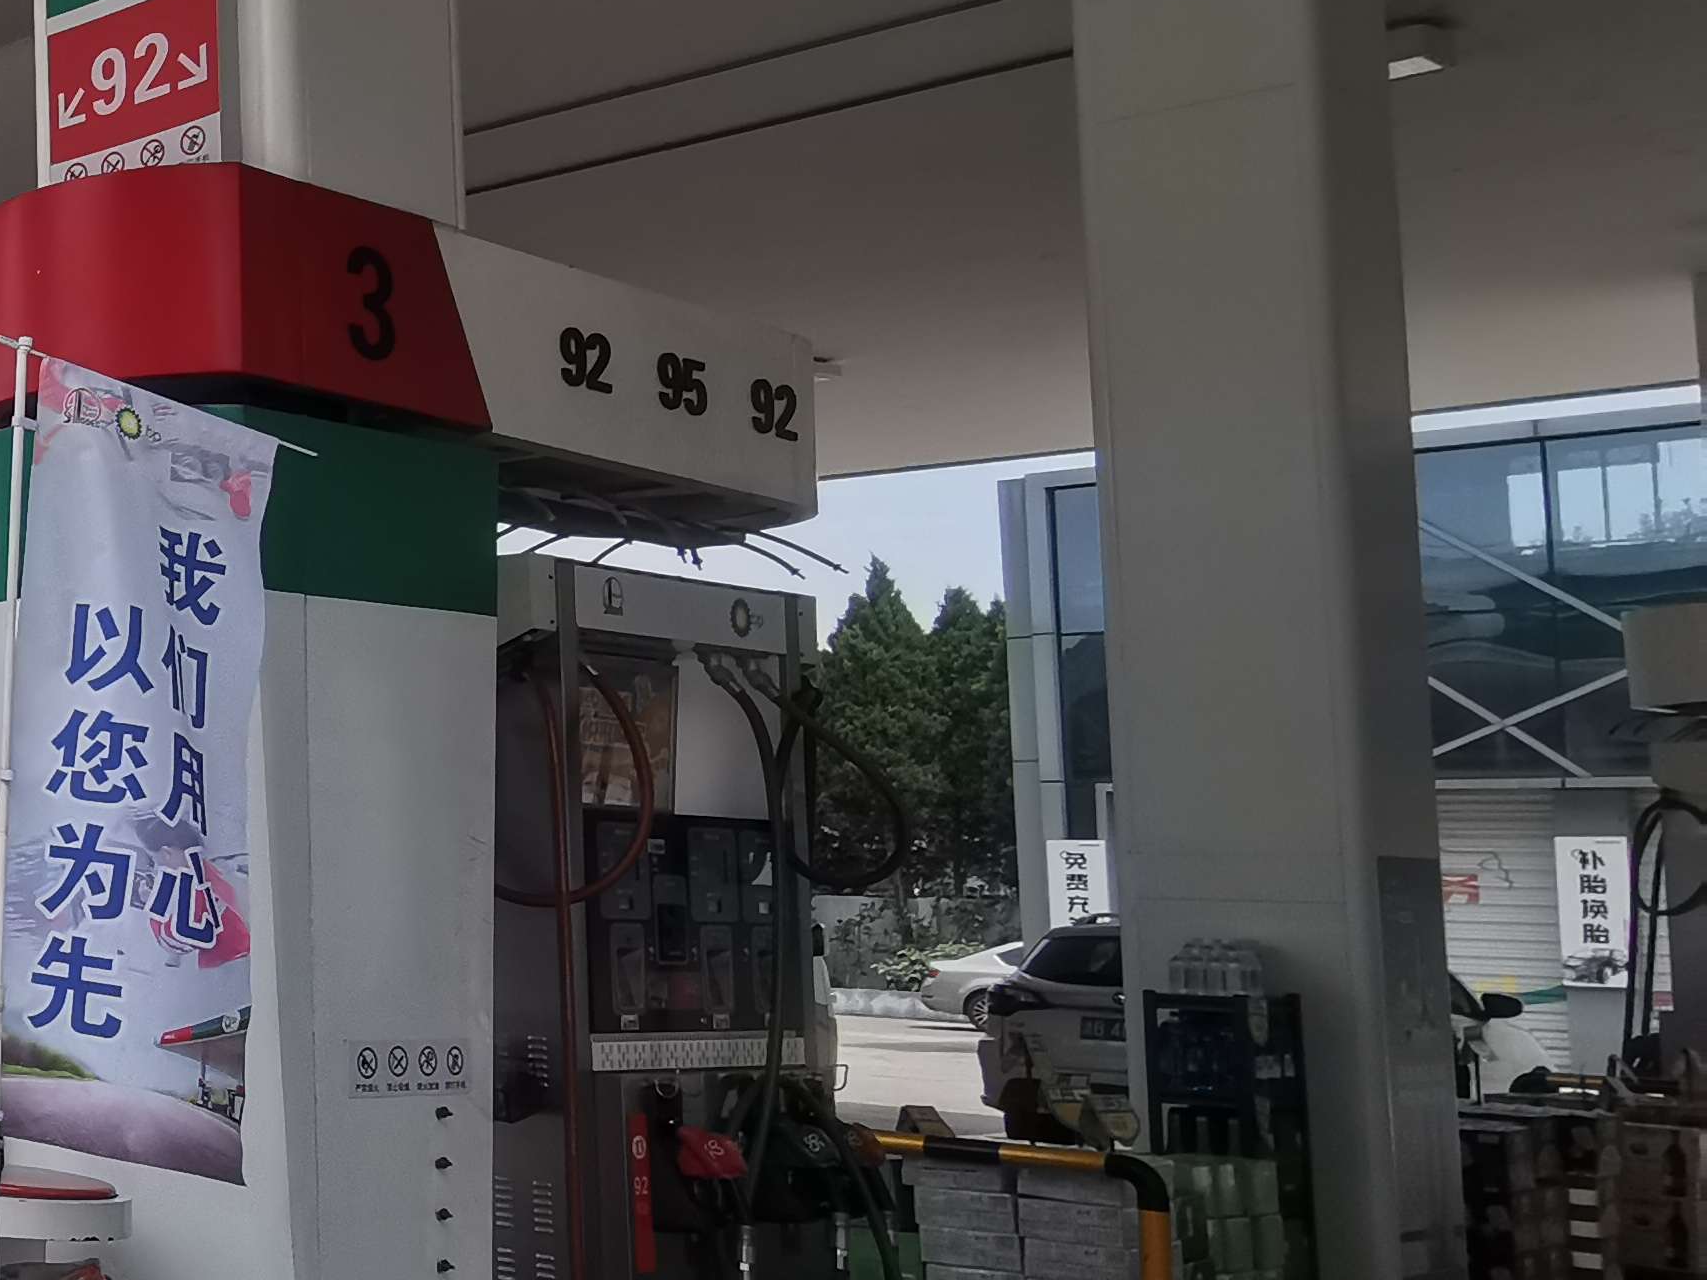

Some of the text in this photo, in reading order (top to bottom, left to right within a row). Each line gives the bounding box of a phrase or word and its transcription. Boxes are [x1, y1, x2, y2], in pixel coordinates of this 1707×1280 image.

[91, 32, 170, 118] 92
[346, 246, 394, 360] 3
[559, 326, 798, 442] 92 95 92
[150, 524, 227, 947] 我们用心
[28, 599, 154, 1043] 以您为先
[1065, 851, 1090, 926] 免费充
[1578, 850, 1610, 944] 补胎换胎
[633, 1176, 649, 1196] 92
